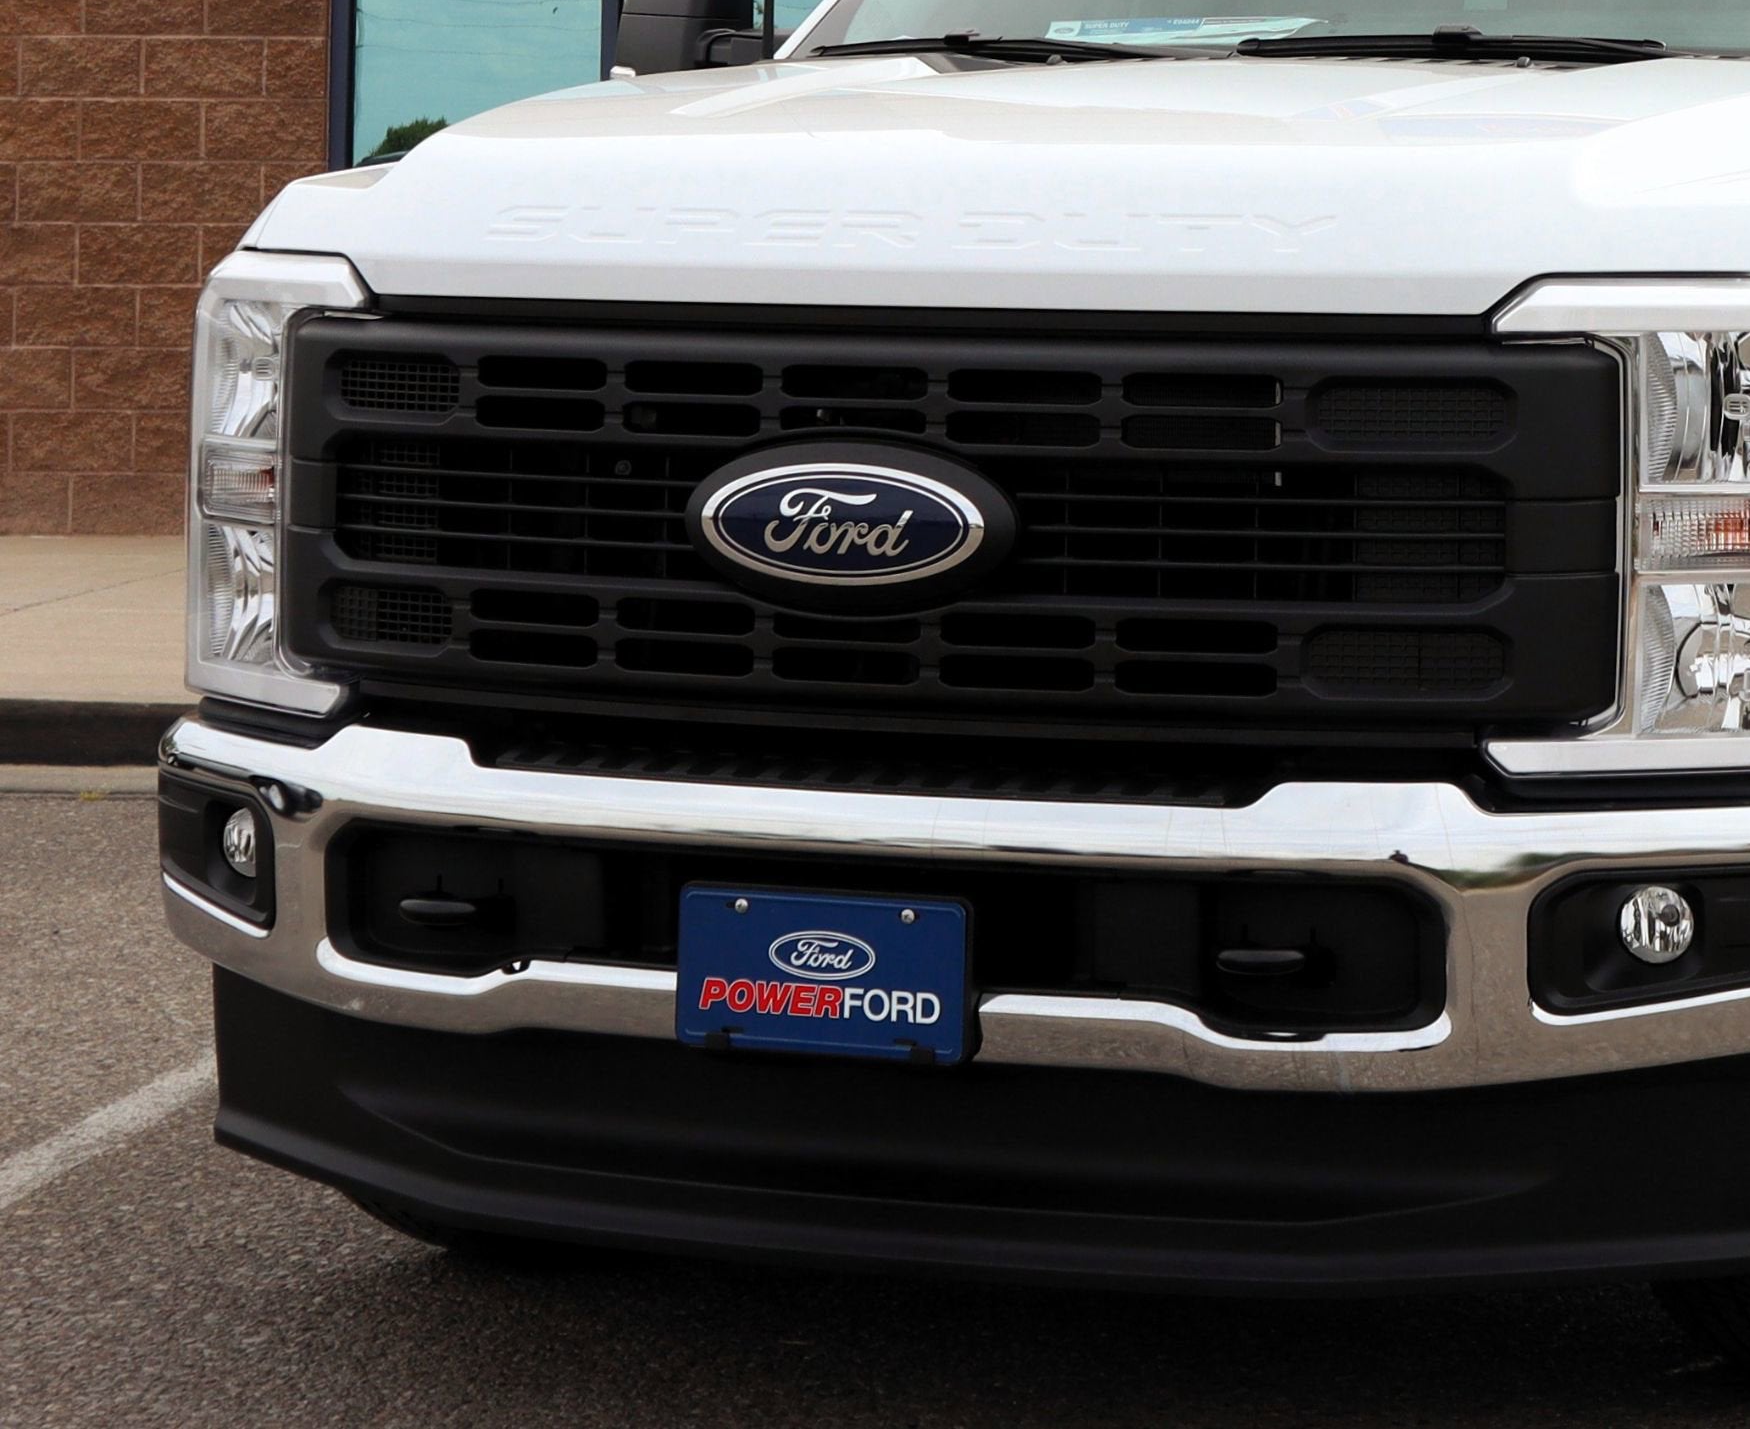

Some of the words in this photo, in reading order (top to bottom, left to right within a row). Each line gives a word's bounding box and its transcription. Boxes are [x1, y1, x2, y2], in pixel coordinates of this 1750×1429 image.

[481, 205, 924, 250] SUPER
[952, 210, 1339, 253] DUTY
[764, 486, 914, 557] Ford
[790, 939, 854, 970] Ford
